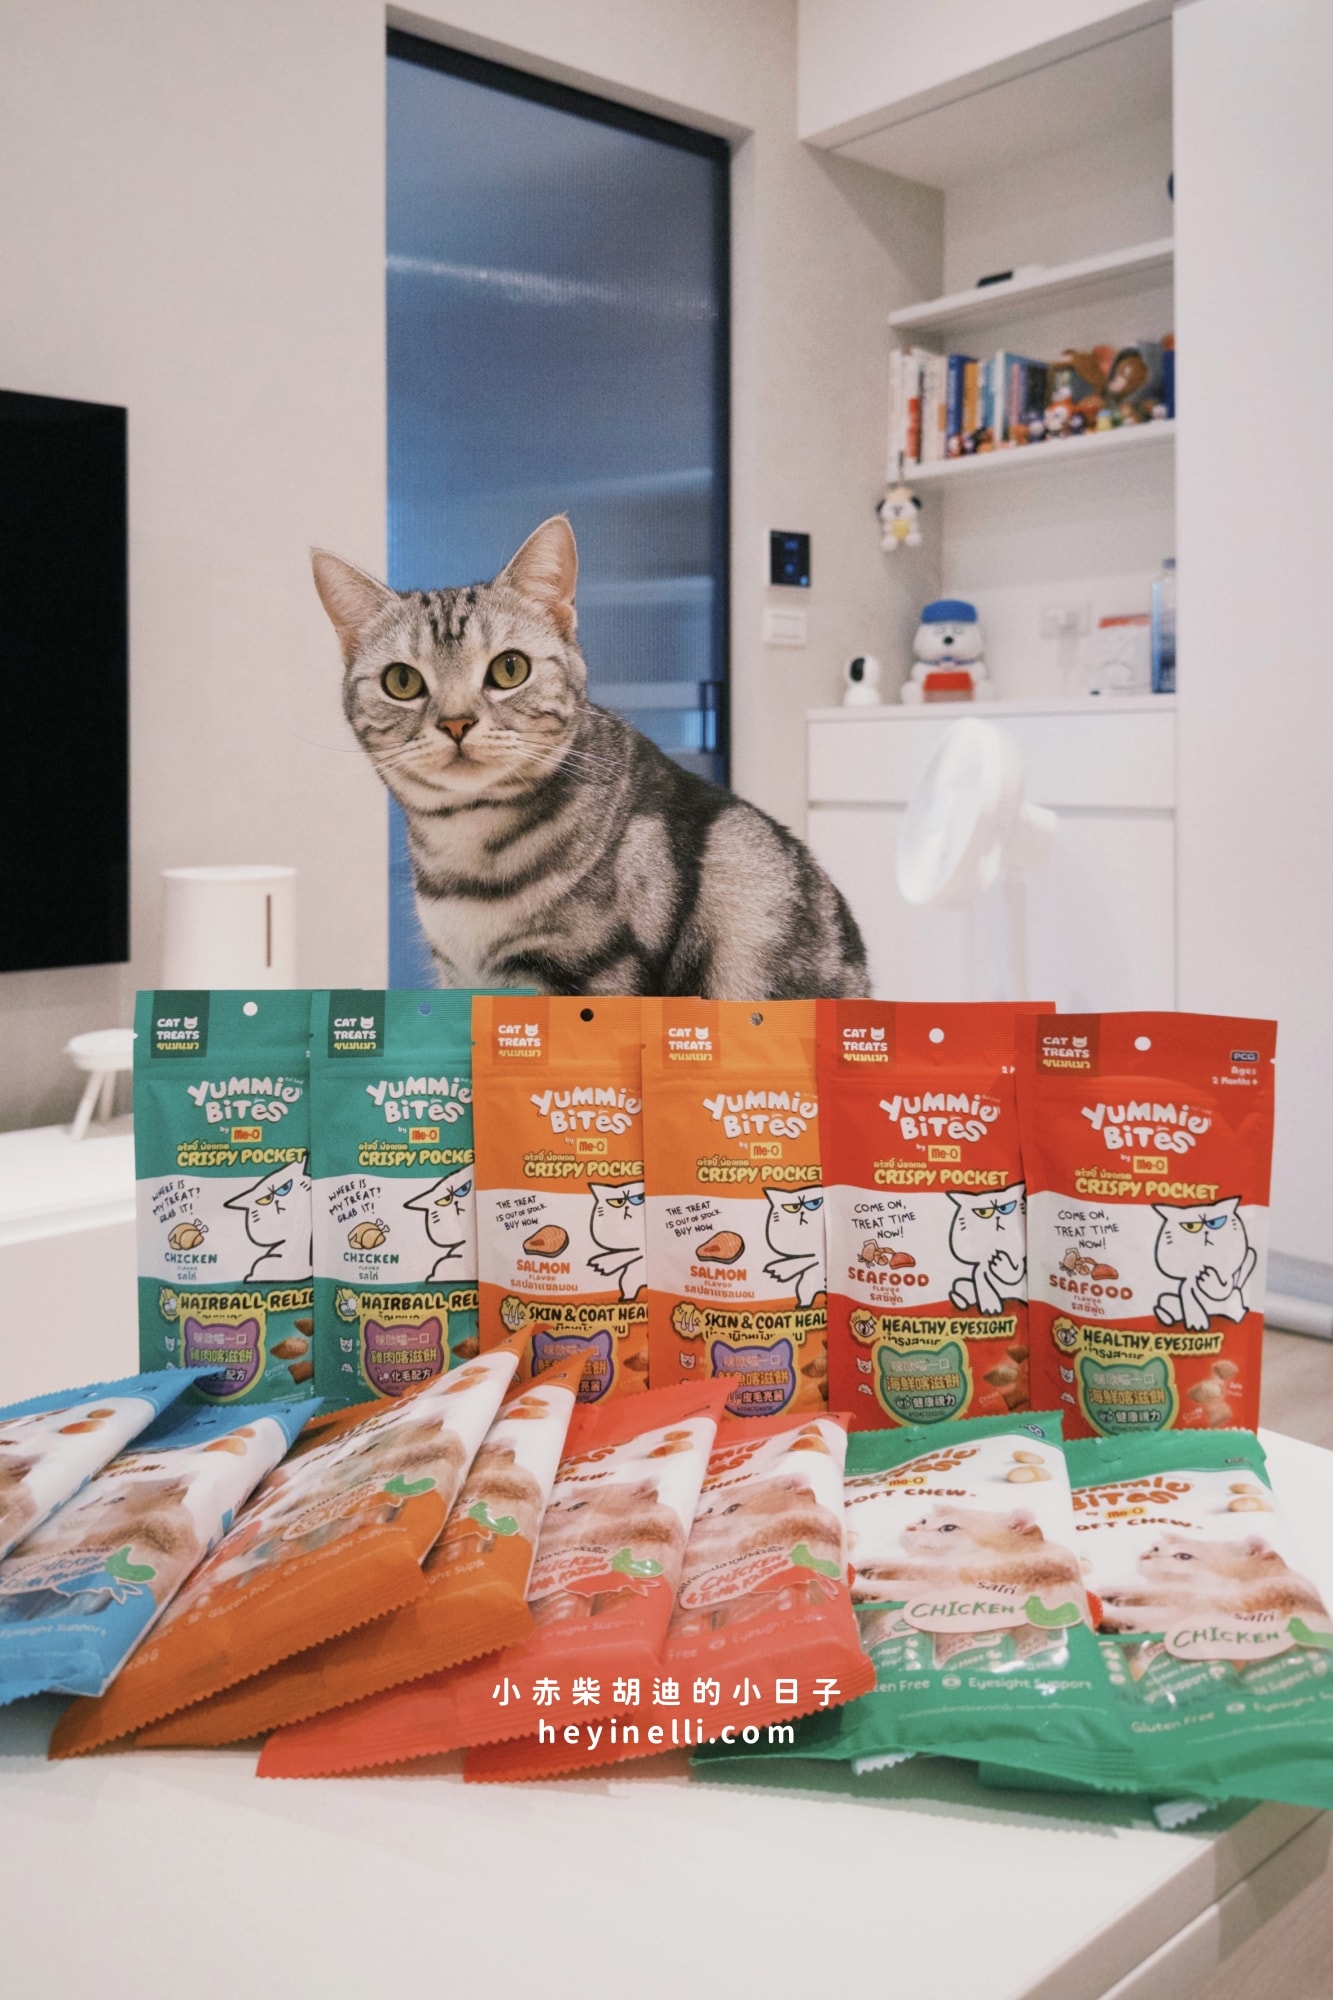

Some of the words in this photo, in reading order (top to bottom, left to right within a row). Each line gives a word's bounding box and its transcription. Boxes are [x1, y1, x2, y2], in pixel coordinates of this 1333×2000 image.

[157, 1018, 180, 1028] CAT
[334, 1018, 357, 1028] CAT
[498, 1024, 522, 1034] CAT
[156, 1030, 200, 1040] TREATS
[333, 1030, 376, 1040] TREATS
[668, 1028, 692, 1037] CAT
[843, 1028, 867, 1038] CAT
[498, 1037, 541, 1047] TREATS
[668, 1041, 712, 1050] TREATS
[843, 1041, 888, 1051] TREATS
[1042, 1037, 1068, 1045] CAT
[1042, 1048, 1090, 1058] TREATS
[233, 1129, 260, 1140] Me-O
[411, 1129, 438, 1140] Me-O
[579, 1141, 605, 1152] Me-O
[753, 1145, 779, 1156] Me-O
[931, 1148, 959, 1159] Me-O
[177, 1151, 238, 1167] CRISPY
[240, 1148, 306, 1163] POCKET
[358, 1150, 416, 1166] CRISPY
[419, 1149, 474, 1164] POCKE
[524, 1161, 584, 1178] CRISPY
[587, 1161, 643, 1177] POCKE
[1136, 1159, 1165, 1171] Me-O
[697, 1166, 759, 1183] CRISPY
[874, 1169, 937, 1186] CRISPY
[940, 1169, 1009, 1186] POCKET
[152, 1181, 173, 1202] WHERE
[177, 1179, 185, 1189] IS
[329, 1181, 355, 1201] WHERE
[359, 1179, 366, 1189] IS
[1075, 1178, 1143, 1198] CRISPY
[1145, 1181, 1219, 1200] POCKET
[153, 1202, 164, 1216] MY
[164, 1187, 200, 1206] TREAT?
[329, 1201, 343, 1216] MY
[344, 1187, 381, 1206] TREAT?
[496, 1200, 511, 1208] THE
[514, 1195, 536, 1207] TREAT
[665, 1206, 682, 1215] THE
[685, 1201, 711, 1213] TREAT
[854, 1202, 885, 1213] COME
[887, 1199, 906, 1210] ON,
[160, 1208, 177, 1223] GRAB
[179, 1203, 193, 1215] IT!
[337, 1208, 357, 1223] GRAB
[361, 1202, 374, 1215] IT!
[496, 1214, 504, 1222] IS
[505, 1211, 517, 1219] OUT
[527, 1204, 547, 1214] STOCK
[665, 1221, 674, 1229] IS
[675, 1217, 689, 1225] OUT
[700, 1209, 722, 1220] STOCK
[1058, 1210, 1086, 1221] COME
[1088, 1209, 1109, 1220] ON,
[504, 1220, 519, 1230] BUY
[521, 1218, 538, 1226] NOW
[851, 1217, 884, 1229] TREAT
[888, 1211, 916, 1224] TIME
[674, 1226, 692, 1237] BUY
[694, 1224, 713, 1232] NOW
[877, 1225, 904, 1239] NOW!
[1053, 1225, 1086, 1237] TREAT
[1089, 1223, 1120, 1235] TIME
[1079, 1237, 1107, 1250] NOW!
[165, 1252, 218, 1264] CHICKEN
[343, 1252, 399, 1264] CHICKEN
[517, 1259, 571, 1274] SALMON
[690, 1265, 747, 1280] SALMON
[848, 1266, 929, 1287] SEAFOOD
[1049, 1274, 1133, 1300] SEAFOOD
[181, 1291, 264, 1311] HAIRBALL
[270, 1291, 314, 1309] RELIE
[362, 1291, 445, 1311] HAIRBALL
[452, 1290, 479, 1308] REL
[529, 1306, 562, 1322] SKIN
[565, 1308, 576, 1321] &
[579, 1308, 615, 1322] COAT
[704, 1313, 739, 1328] SKIN
[742, 1314, 754, 1328] &
[756, 1314, 792, 1328] COAT
[795, 1312, 827, 1328] HEAL
[882, 1318, 946, 1335] HEALTHY
[951, 1319, 1014, 1336] EYESIGHT
[1083, 1328, 1150, 1347] HEALTHY
[1155, 1335, 1221, 1352] EYESIGHT
[371, 1347, 437, 1364] 雞肉喀滋餅
[392, 1369, 432, 1382] 化毛配方
[886, 1373, 959, 1391] 海鮮喀滋餅
[913, 1394, 956, 1408] 健康視力
[844, 1489, 896, 1508] SOFT
[904, 1488, 967, 1496] CHEW
[1126, 1518, 1192, 1528] CHEW
[910, 1600, 1015, 1618] CHICKEN
[1173, 1627, 1280, 1648] CHICKEN
[899, 1679, 931, 1692] Free
[968, 1677, 1031, 1689] Eyesight
[1131, 1719, 1180, 1733] Gluten
[1184, 1711, 1215, 1725] Free
